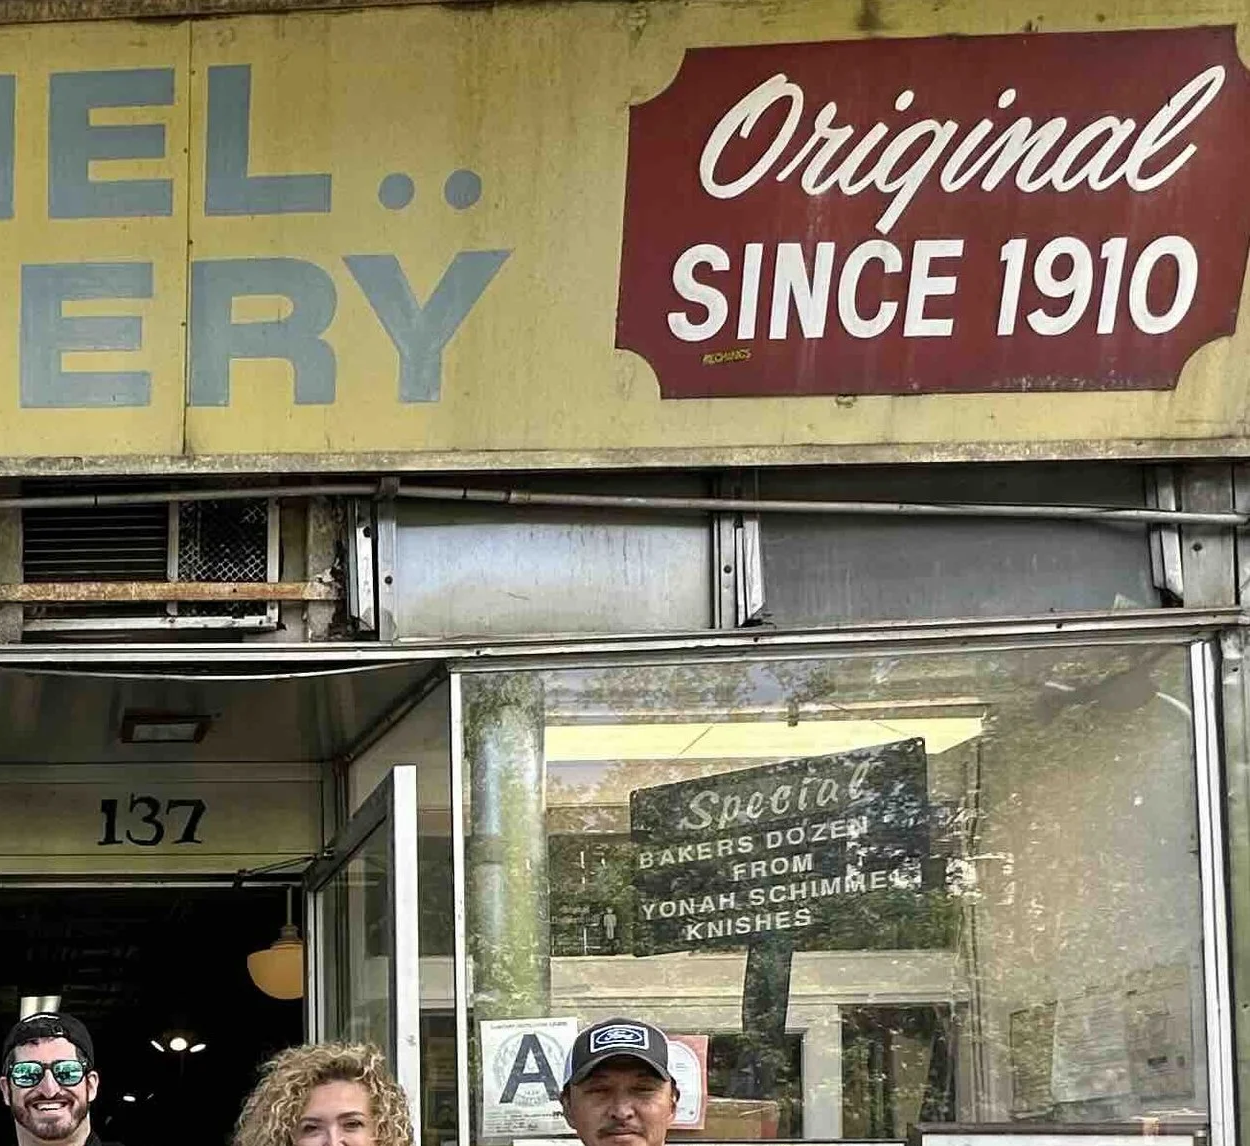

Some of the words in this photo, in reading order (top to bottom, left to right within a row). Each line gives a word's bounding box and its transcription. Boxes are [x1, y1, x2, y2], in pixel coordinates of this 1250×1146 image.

[699, 64, 1226, 233] Original
[667, 239, 964, 340] SINCE
[997, 235, 1200, 336] 1910
[97, 792, 207, 846] 137
[682, 760, 876, 831] Special
[639, 834, 754, 869] BAKERS
[766, 815, 868, 849] DOZEN
[733, 853, 813, 881] FROM
[642, 891, 736, 922] YONAH
[685, 907, 813, 941] KNISHES
[499, 1034, 563, 1104] A
